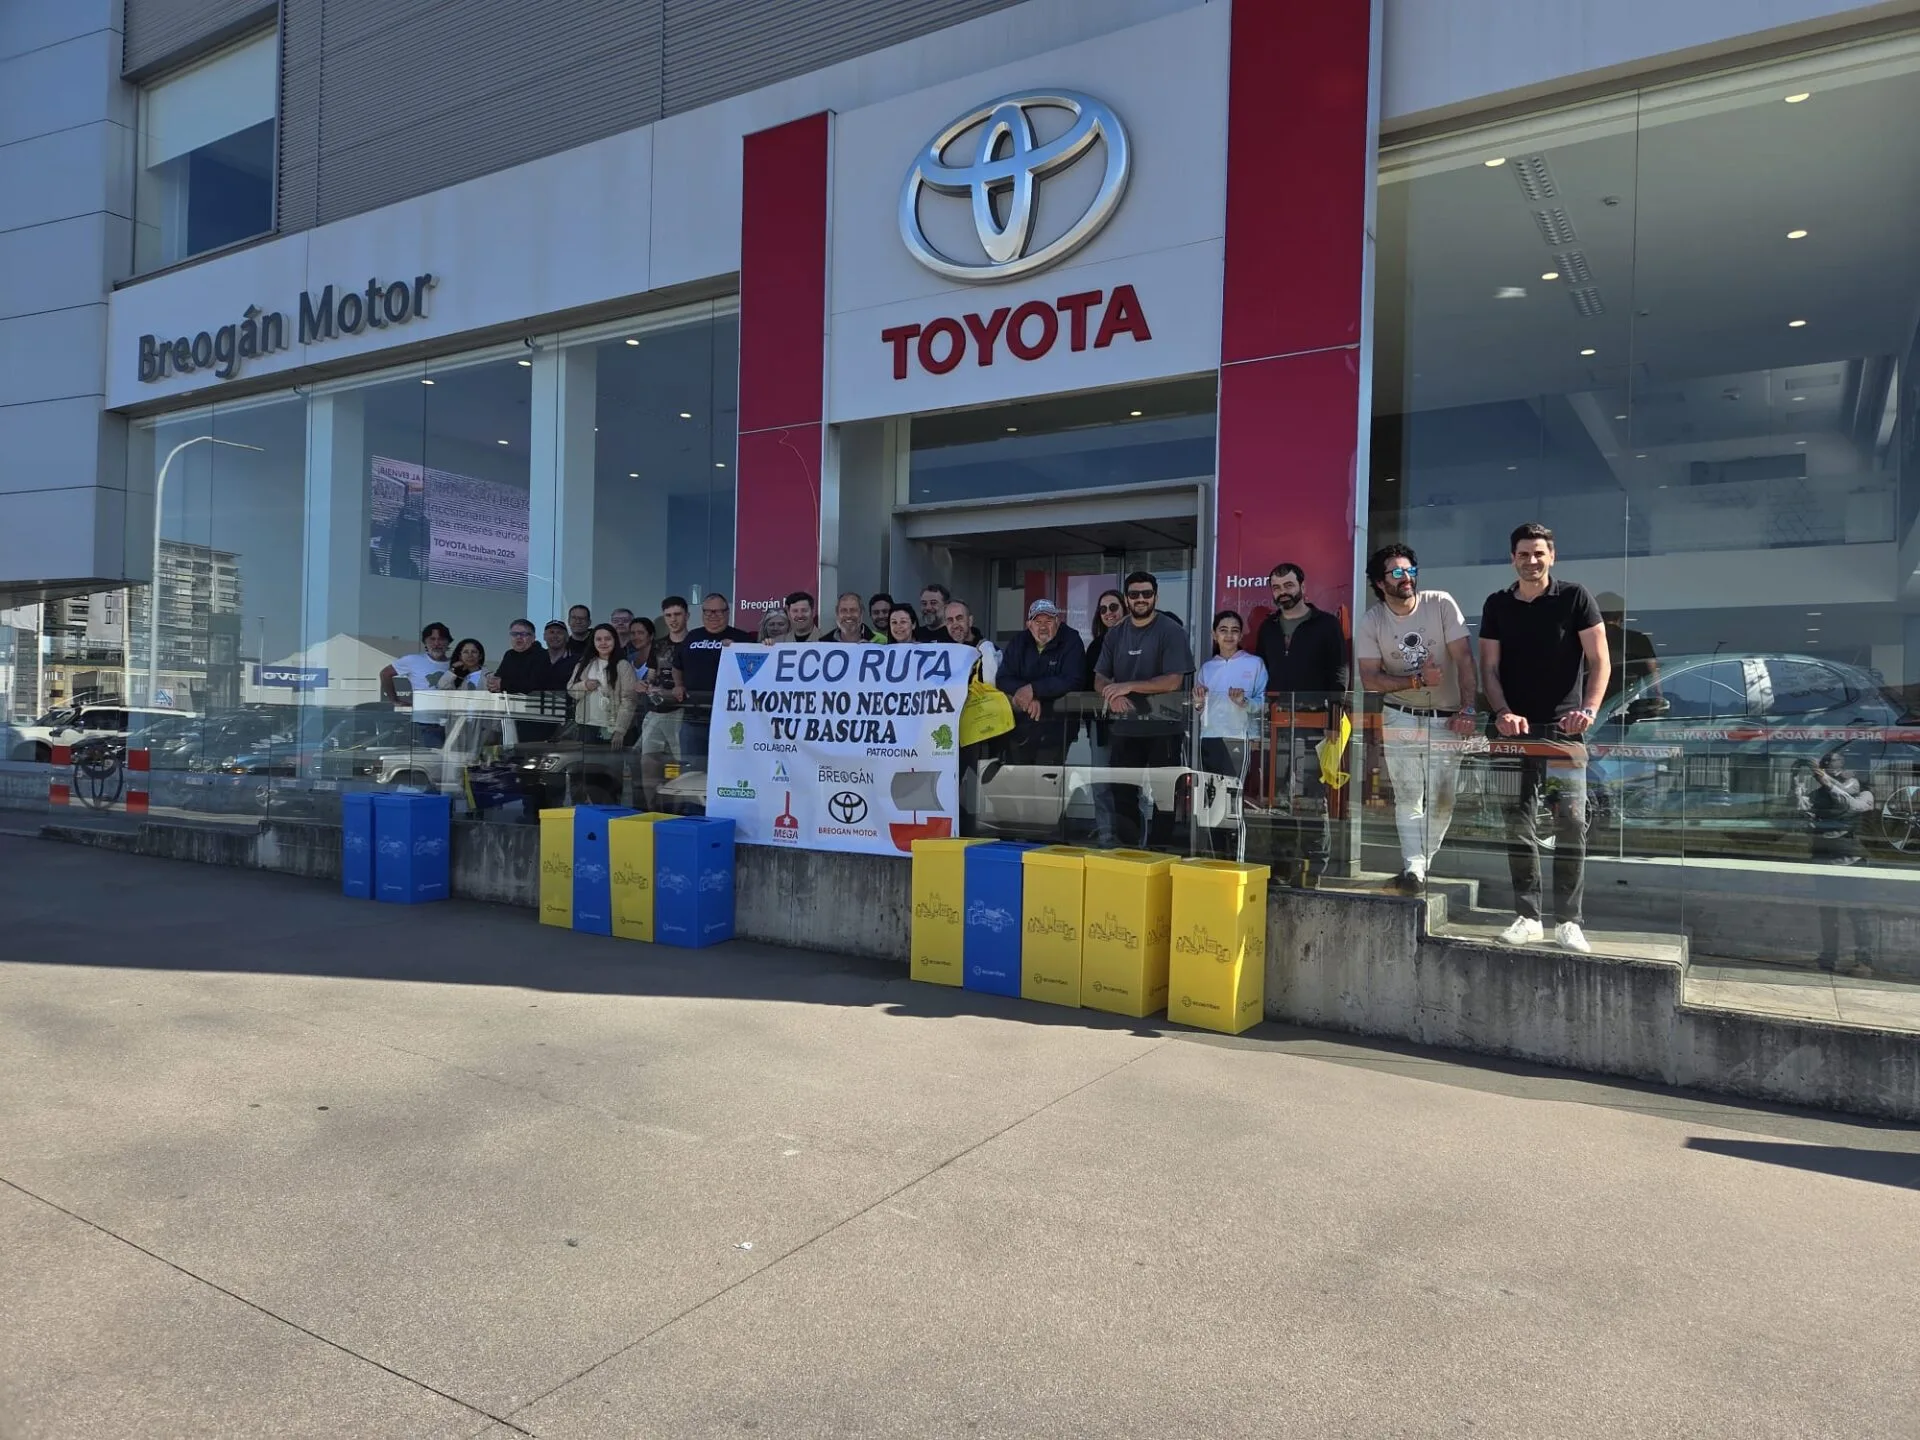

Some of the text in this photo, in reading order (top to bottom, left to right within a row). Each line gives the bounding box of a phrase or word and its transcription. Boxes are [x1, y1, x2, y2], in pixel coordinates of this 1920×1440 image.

[298, 273, 439, 344] Motor
[881, 284, 1152, 380] TOYOTA
[434, 537, 467, 551] TOYOTA
[497, 548, 516, 559] 2025
[1226, 575, 1269, 588] Horar
[740, 597, 780, 612] Breogán
[689, 640, 723, 649] adida
[775, 649, 952, 683] ECO RUTA
[726, 689, 746, 712] EL
[751, 690, 817, 714] MONTE
[821, 691, 851, 715] NO
[856, 688, 955, 716] NECESITA
[771, 717, 897, 744] TU BASURA
[753, 742, 798, 753] COLABORA
[866, 747, 918, 758] PATROCINA
[818, 768, 874, 784] BREOGÁN
[773, 829, 799, 840] MEGA
[818, 827, 878, 837] BREOGAN MOTOR
